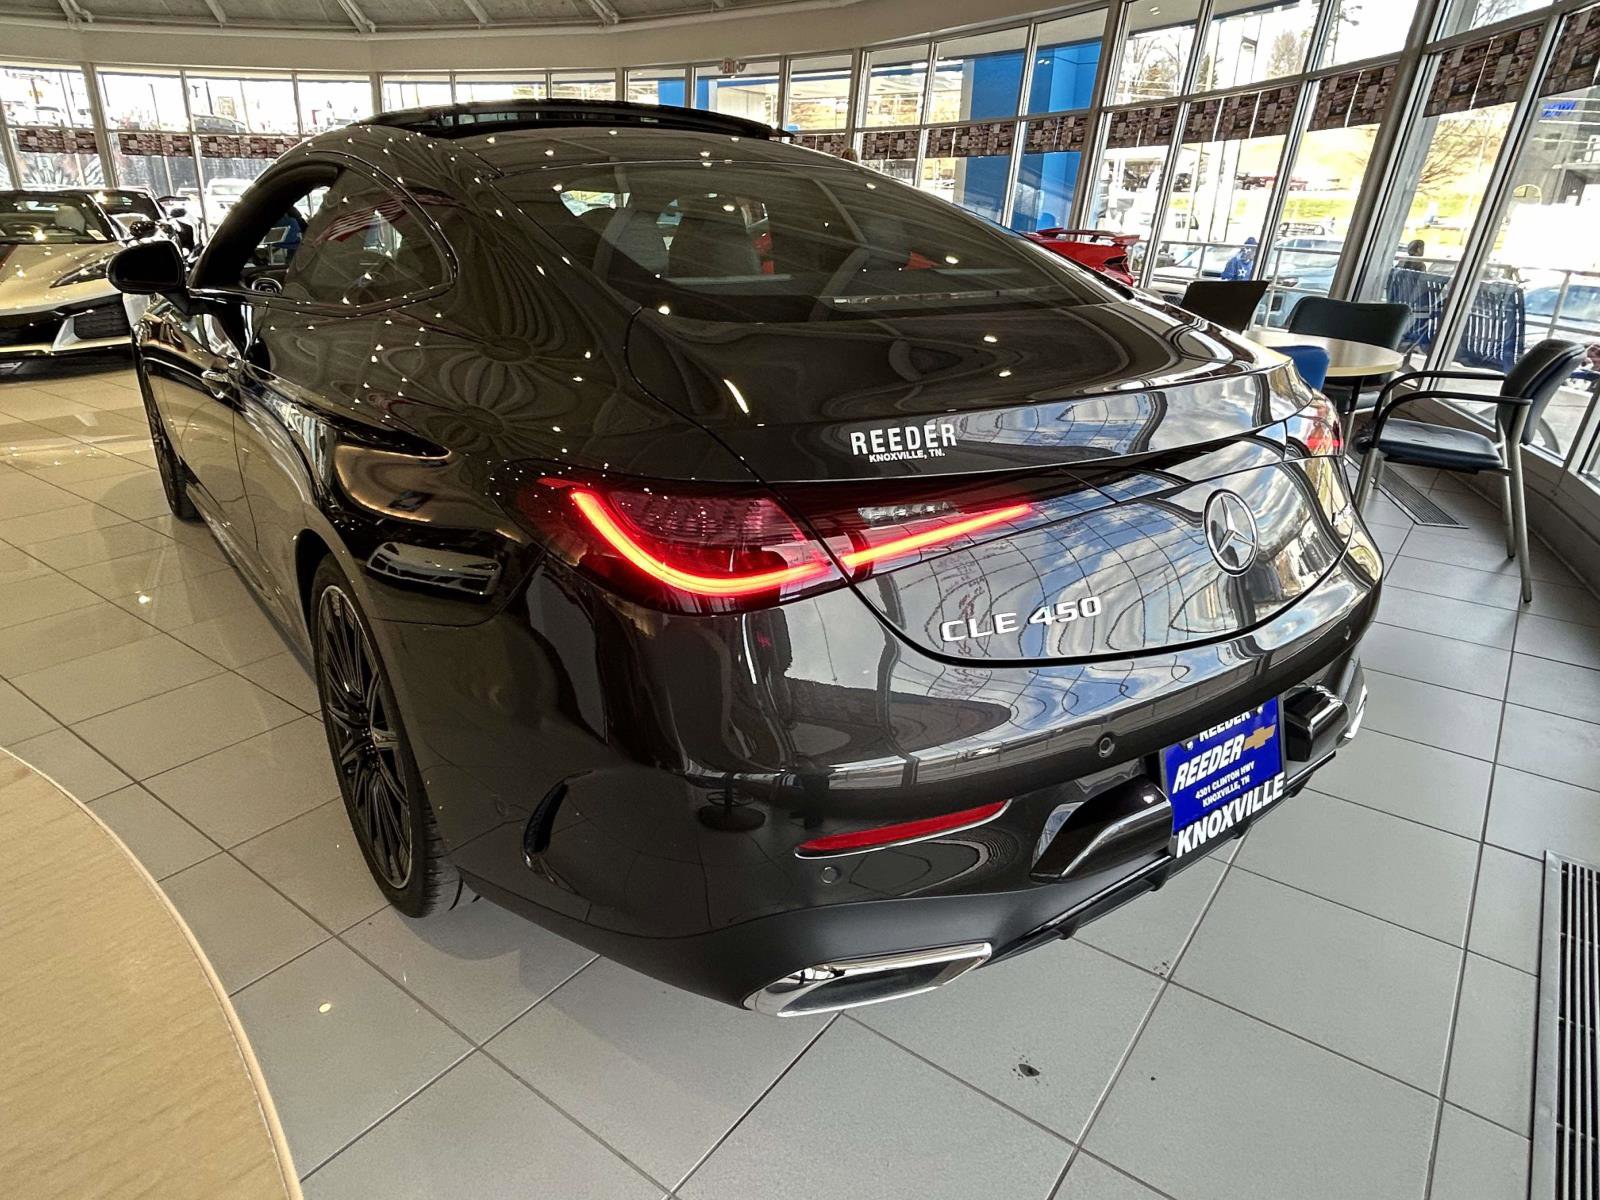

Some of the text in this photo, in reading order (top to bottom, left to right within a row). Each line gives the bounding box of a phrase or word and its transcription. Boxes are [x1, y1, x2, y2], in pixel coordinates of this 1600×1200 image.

[850, 423, 957, 455] REEDER
[869, 448, 945, 463] KNOXVILLE, TN.
[940, 596, 1102, 642] CLE 450
[1172, 734, 1245, 794] REEDER
[1211, 769, 1240, 791] CLINTON
[1240, 760, 1255, 775] HWY
[1202, 781, 1241, 808] KNOXVILLE,
[1176, 771, 1285, 859] KNOXVILLE
